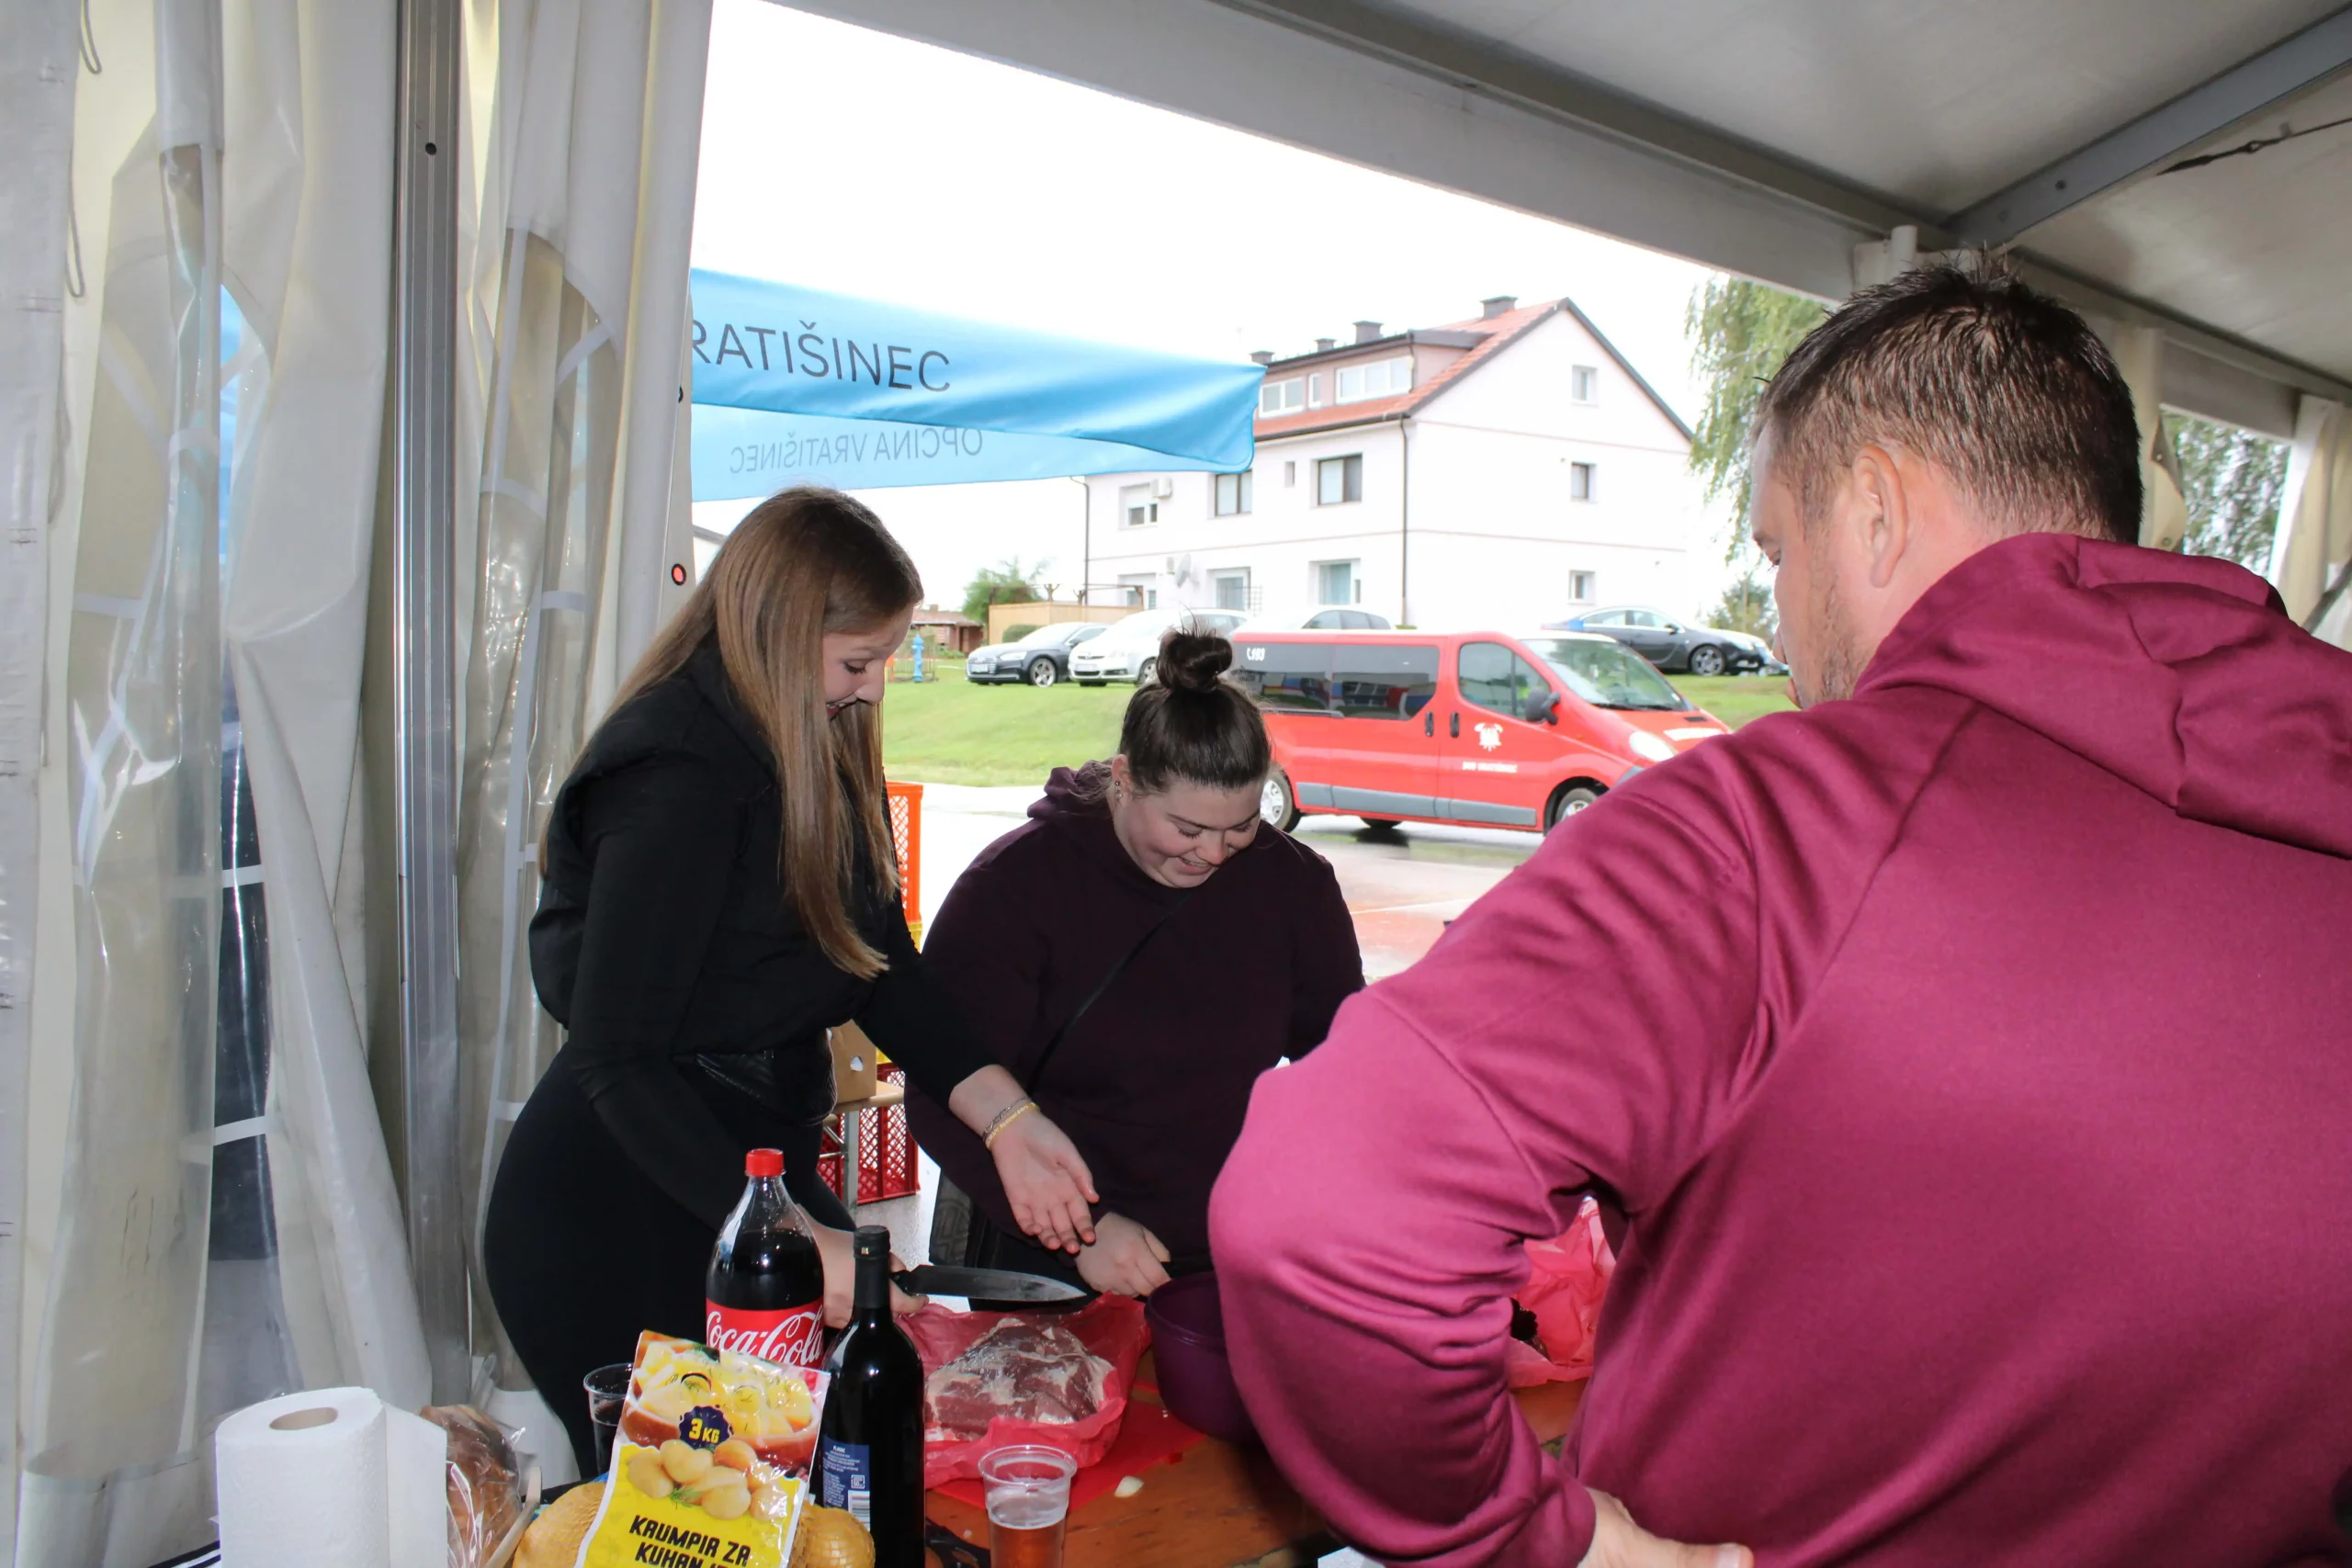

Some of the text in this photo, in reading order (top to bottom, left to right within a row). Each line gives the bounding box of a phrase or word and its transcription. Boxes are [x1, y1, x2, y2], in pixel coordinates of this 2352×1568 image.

[692, 320, 950, 392] RATIŠINEC
[707, 1304, 824, 1365] Coca-Cola
[689, 1418, 720, 1444] 3 KG
[629, 1515, 751, 1567] KRUMPIR ZA
[635, 1542, 729, 1568] KUHAN
